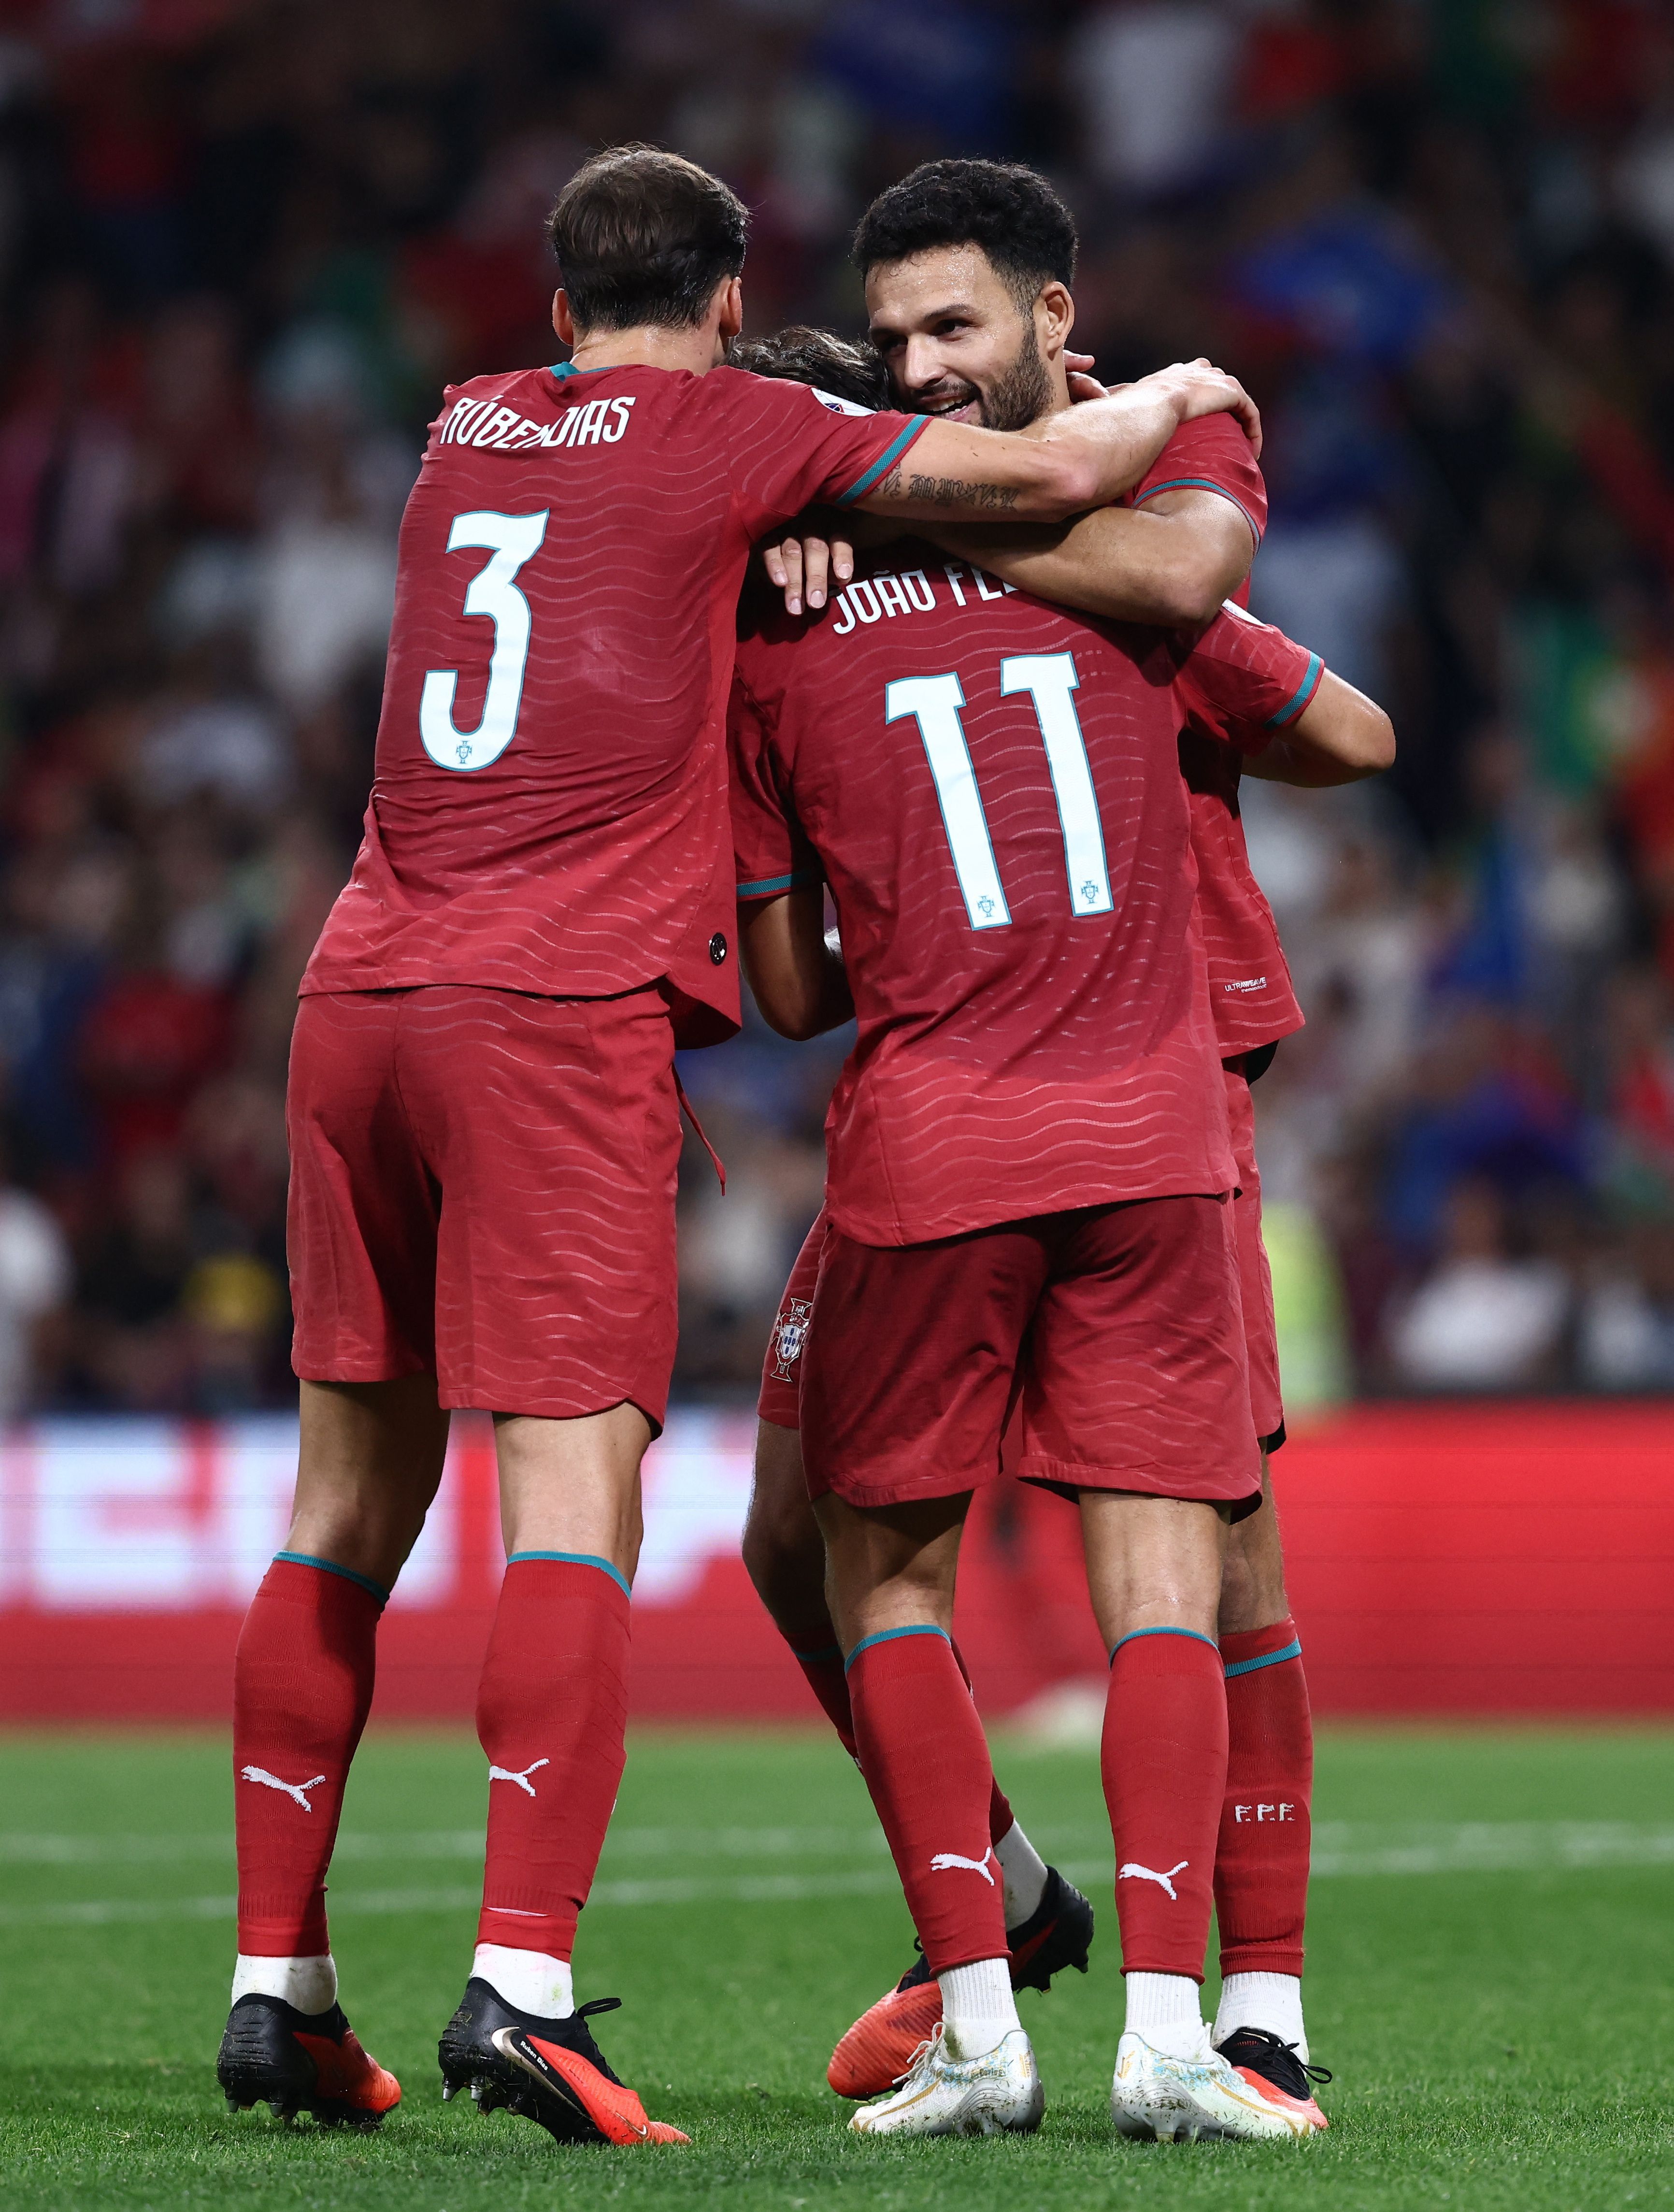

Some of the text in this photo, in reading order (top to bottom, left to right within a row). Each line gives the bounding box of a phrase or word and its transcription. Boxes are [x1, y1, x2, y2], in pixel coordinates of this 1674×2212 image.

[540, 396, 636, 448] DIAS
[828, 569, 936, 635] JOÃO
[419, 507, 550, 772] 3
[885, 650, 1114, 931] 11
[1224, 977, 1266, 991] ULTRAWEAVE
[520, 2040, 548, 2071] Ruben Dias
